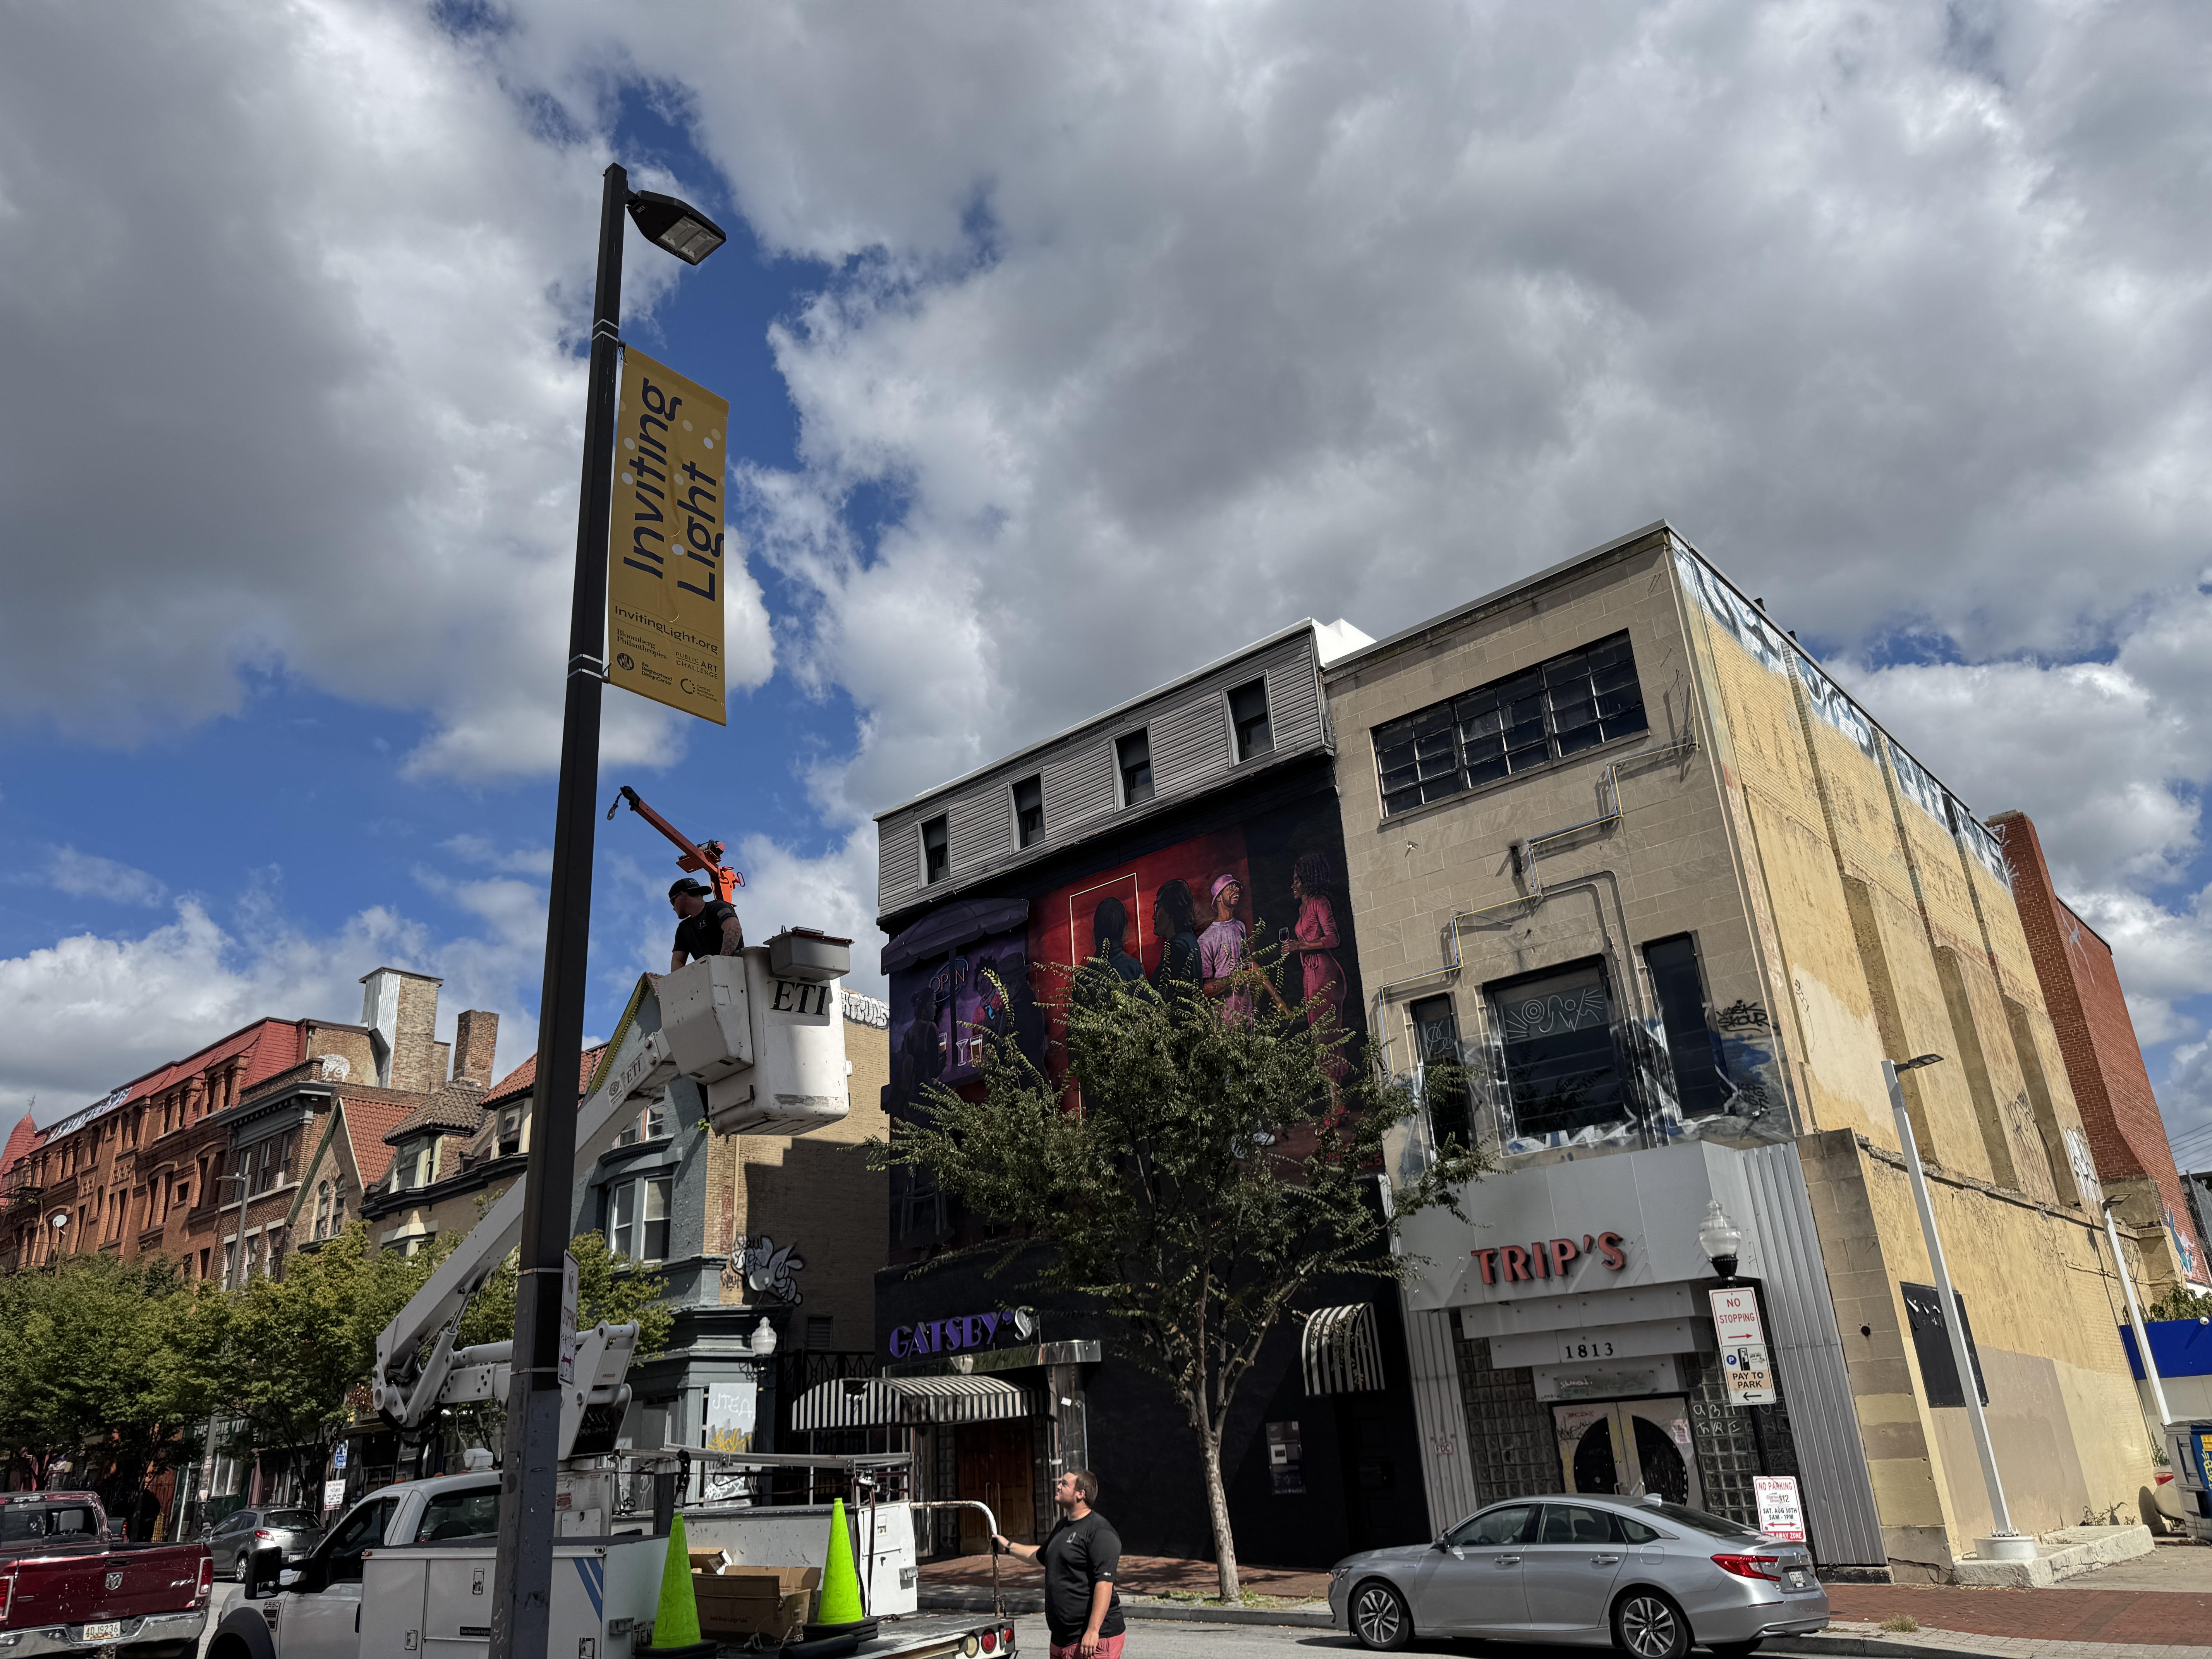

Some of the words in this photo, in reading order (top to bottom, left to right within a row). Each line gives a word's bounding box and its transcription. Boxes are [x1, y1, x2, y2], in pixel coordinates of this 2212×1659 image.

[623, 377, 682, 579] Inviting
[677, 461, 724, 601] Light
[615, 605, 718, 655] InvitingLight.org
[617, 628, 655, 649] Bloomberg
[617, 635, 667, 659] Philanthropies
[676, 652, 699, 663] PUBLIC
[701, 661, 718, 672] ART
[677, 660, 718, 679] CHALLENGE
[929, 967, 965, 993] OPN
[771, 980, 830, 1015] ETI
[627, 1060, 641, 1084] ETI
[1470, 1231, 1626, 1285] TRIP'S
[1726, 1298, 1741, 1308] NO
[1719, 1312, 1755, 1324] STOPPING
[890, 1305, 1035, 1358] GATSBY'S
[1565, 1342, 1614, 1359] 1813
[1733, 1372, 1749, 1381] PAY
[1738, 1380, 1762, 1389] PARK
[1436, 1443, 1450, 1453] FDC
[1759, 1482, 1766, 1491] NO
[1768, 1482, 1792, 1491] PARKING
